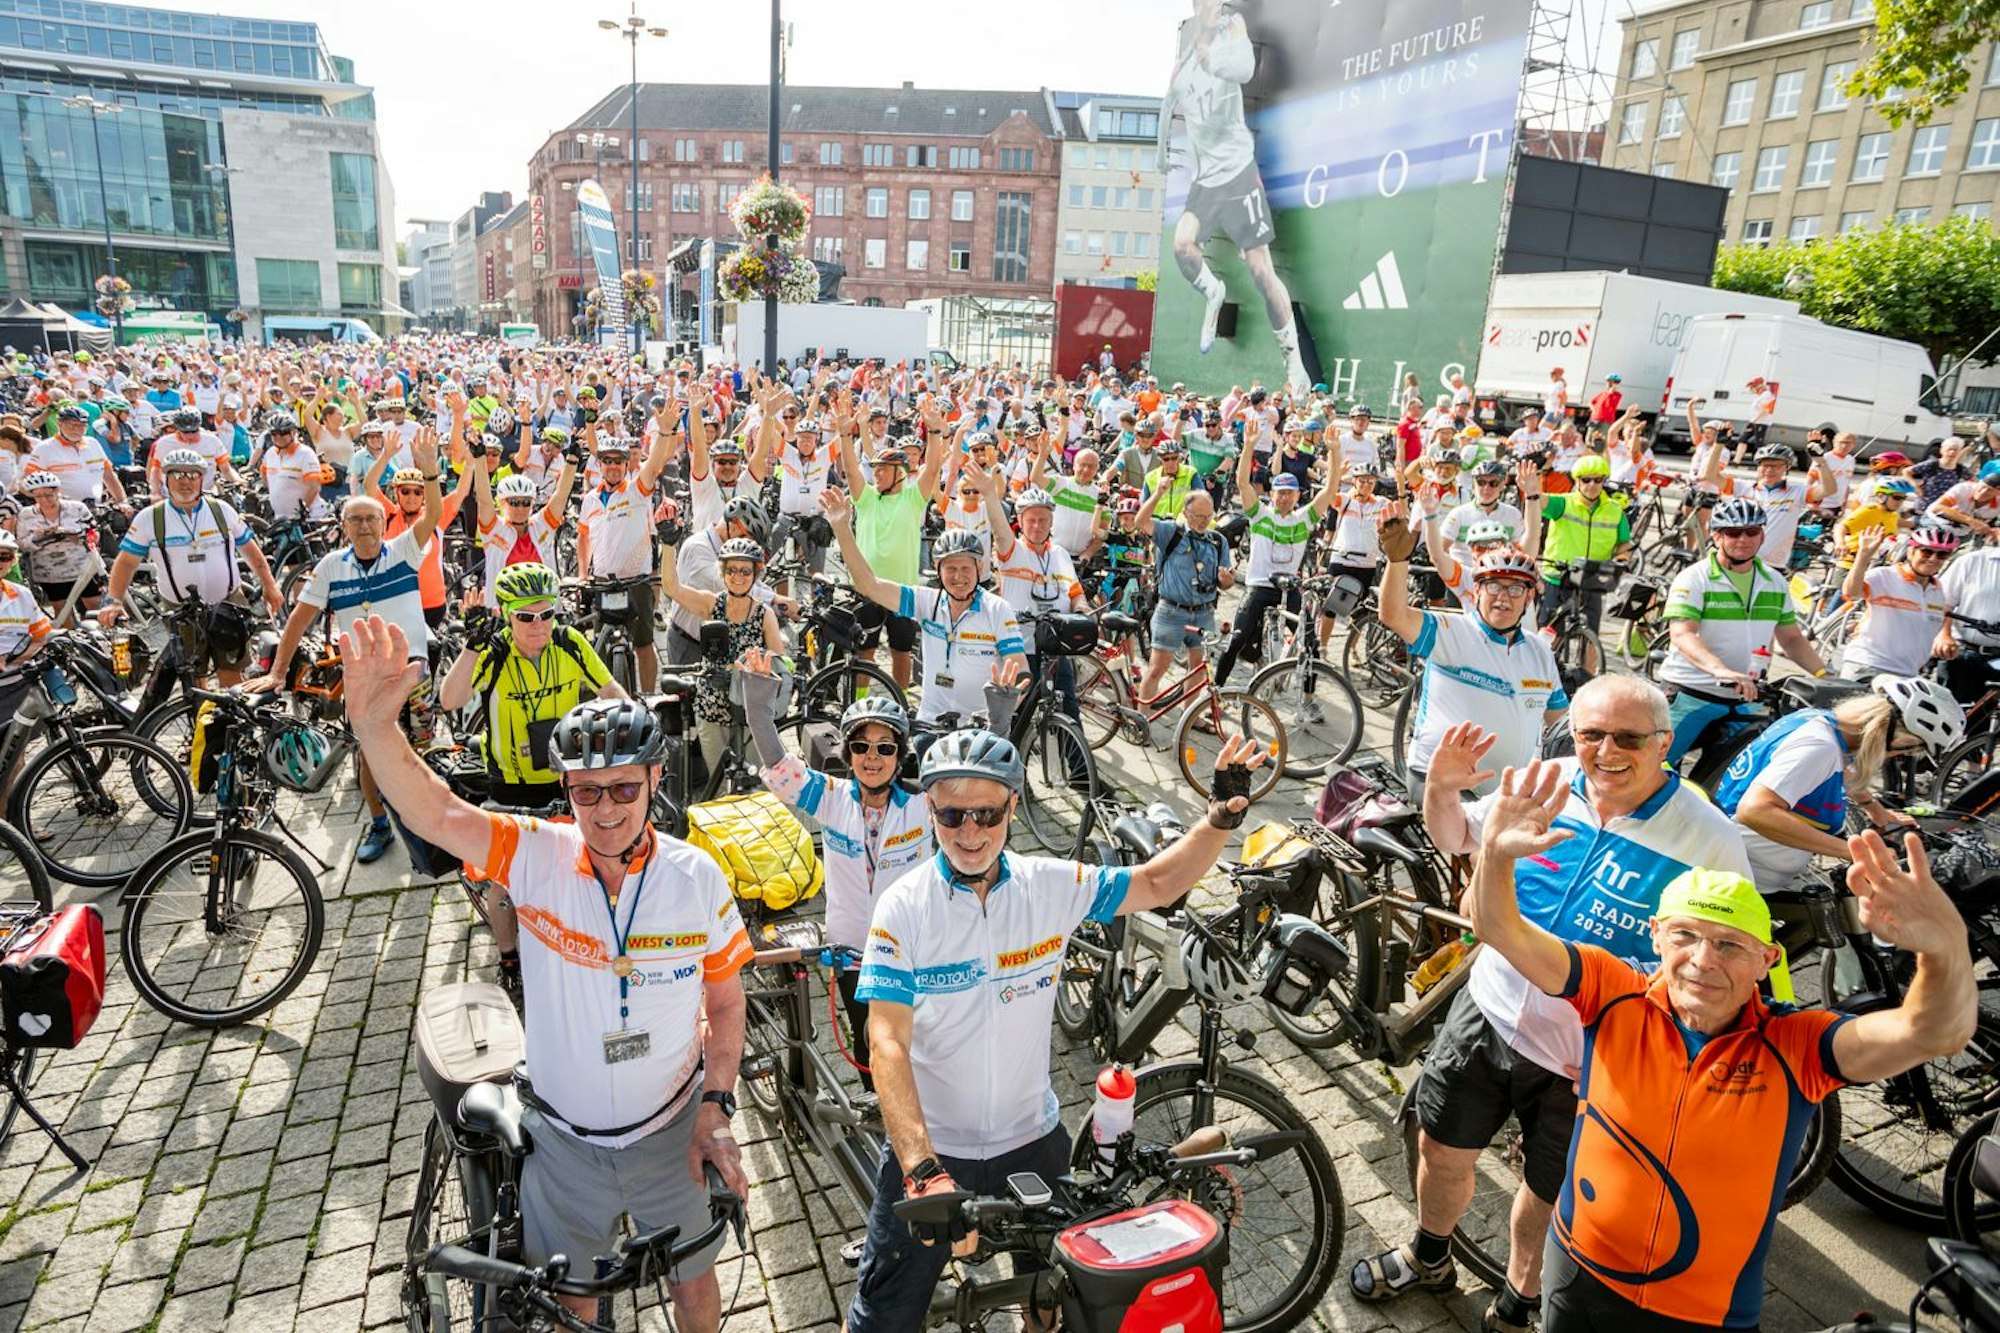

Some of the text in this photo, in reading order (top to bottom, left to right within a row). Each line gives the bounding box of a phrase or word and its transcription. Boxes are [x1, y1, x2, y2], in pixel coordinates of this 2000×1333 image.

[1342, 15, 1484, 80] THE FUTURE
[1337, 52, 1479, 111] IS YOURS
[1242, 188, 1264, 224] 17
[532, 197, 546, 252] AZAD
[505, 678, 577, 701] SCOTT
[1596, 850, 1641, 891] hr
[1589, 897, 1655, 940] RADT
[1687, 899, 1734, 914] GripGrab
[628, 934, 708, 948] WEST LOTTO
[1573, 912, 1615, 941] 2023
[1000, 937, 1062, 967] WEST LOTTO
